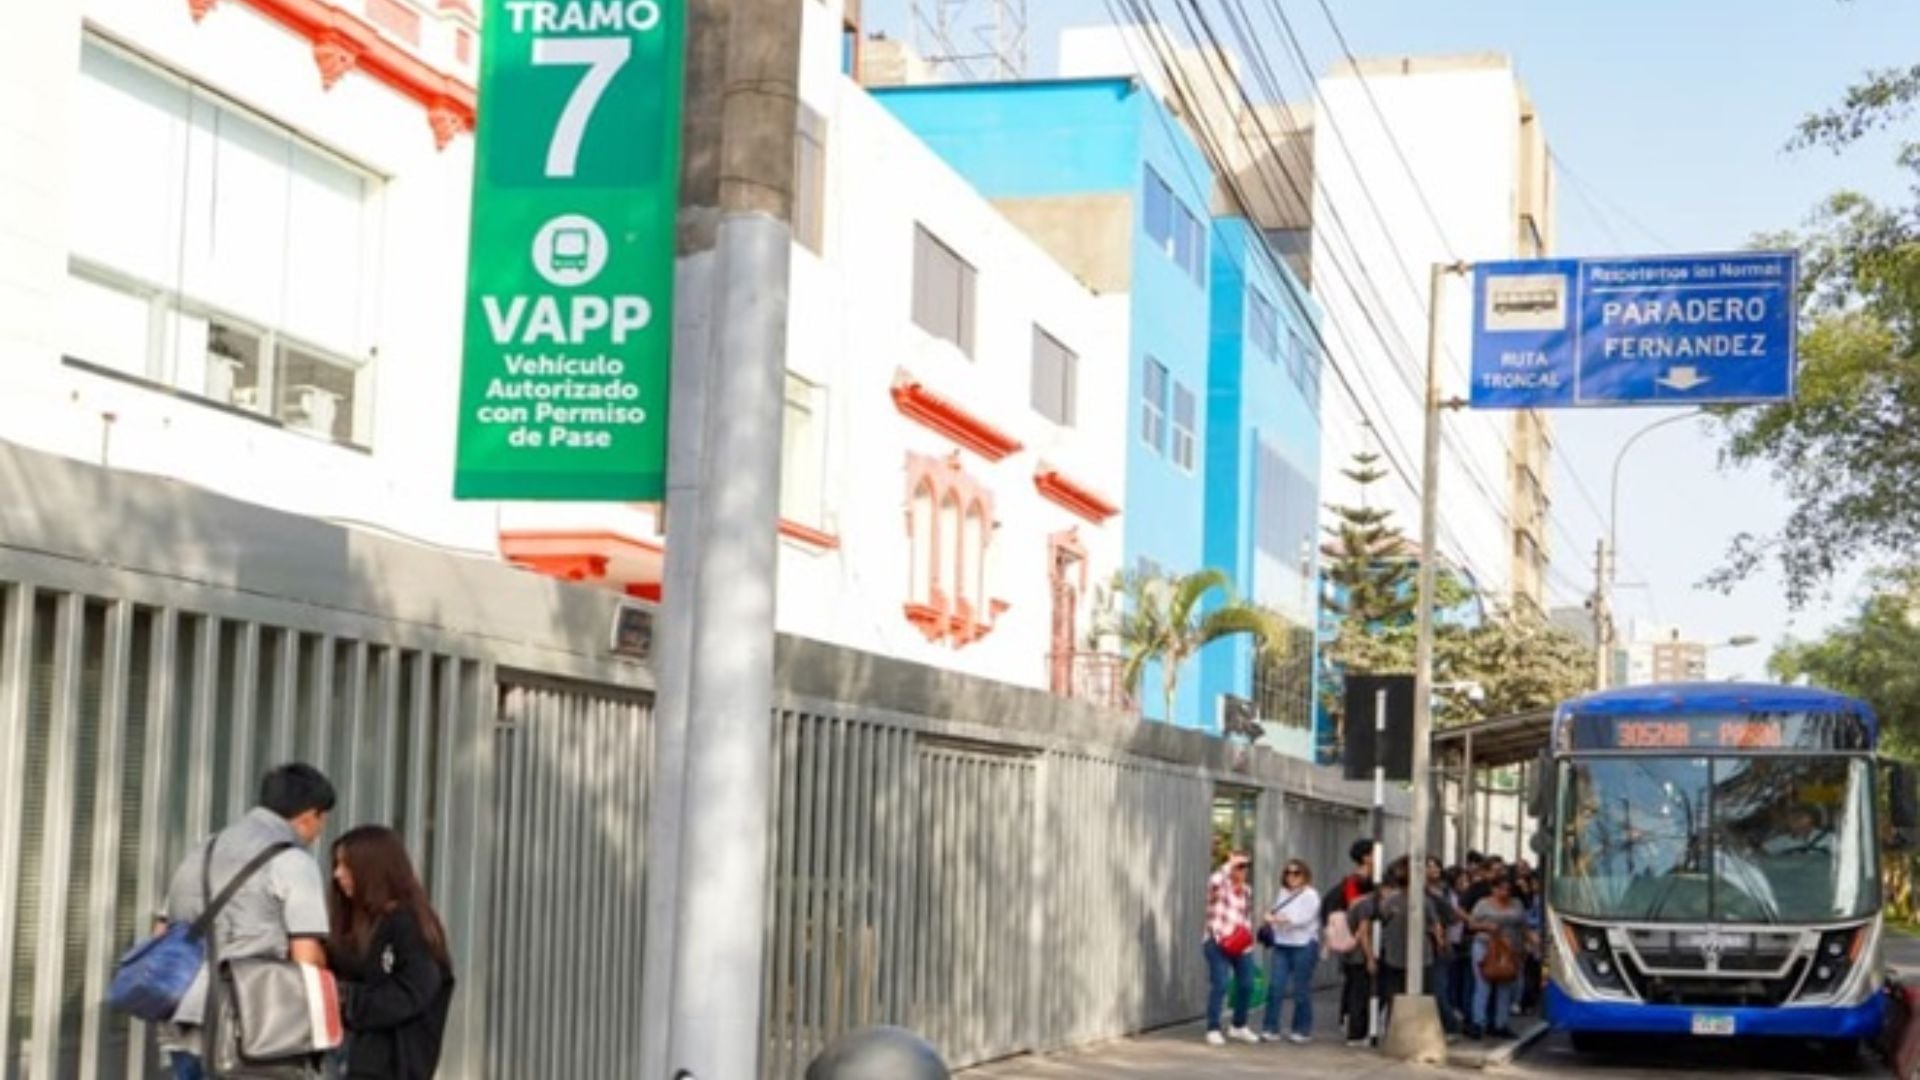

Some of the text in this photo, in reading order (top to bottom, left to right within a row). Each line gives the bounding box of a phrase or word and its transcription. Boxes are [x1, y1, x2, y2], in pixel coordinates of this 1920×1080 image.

[505, 0, 661, 32] TRAMO
[530, 37, 632, 177] 7
[482, 295, 651, 344] VAPP
[1602, 297, 1765, 325] PARADERO
[1604, 334, 1766, 358] FERNANDEZ
[504, 354, 624, 375] Vehículo
[1501, 352, 1548, 368] RUTA
[486, 378, 639, 400] Autorizado
[1482, 372, 1560, 389] TRONCAL
[477, 402, 646, 424] con Permiso
[508, 426, 611, 448] de Pase
